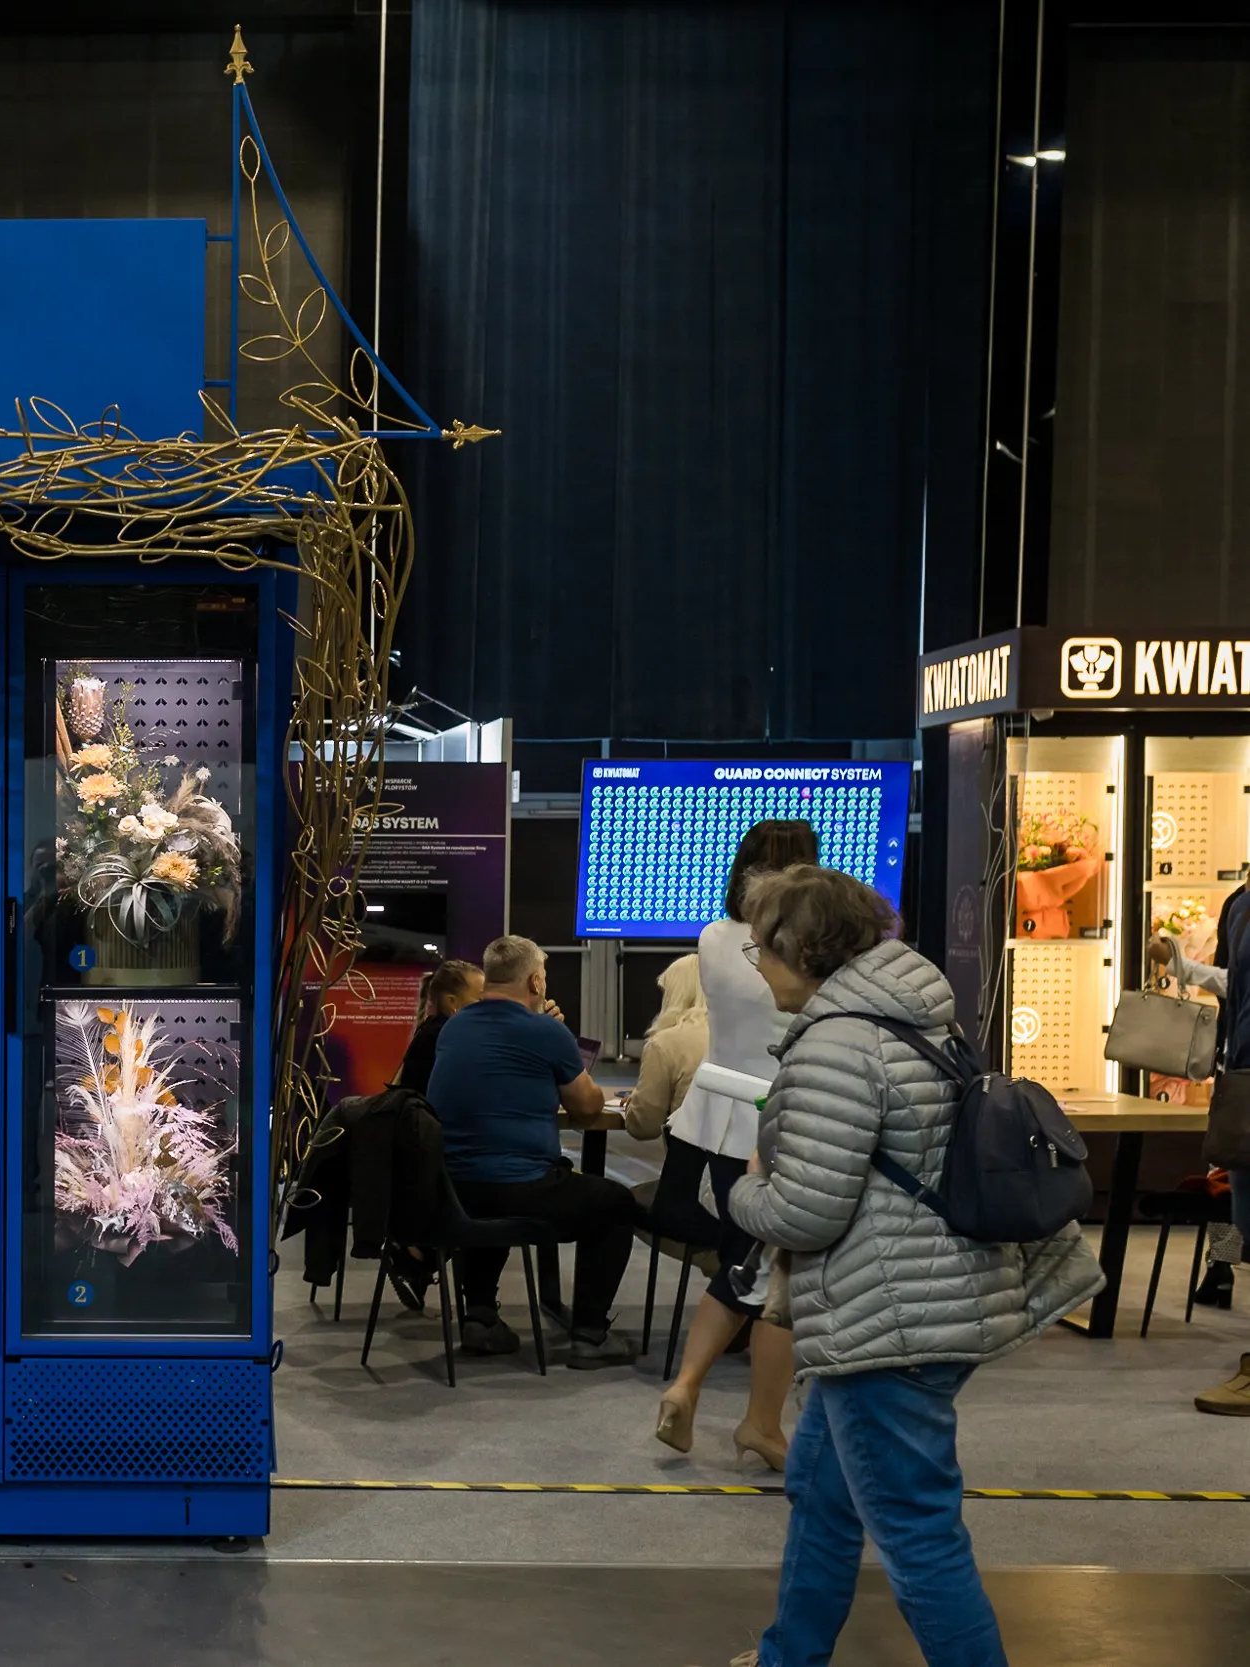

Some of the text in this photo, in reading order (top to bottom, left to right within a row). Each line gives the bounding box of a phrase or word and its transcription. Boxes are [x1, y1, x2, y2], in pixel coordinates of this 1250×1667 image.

[1134, 640, 1250, 695] KWIAT
[923, 644, 1011, 715] KWIATOMAT
[603, 767, 640, 778] KWIATOMAT
[713, 767, 882, 781] GUARD CONNECT SYSTEM
[382, 817, 439, 829] SYSTEM
[77, 949, 89, 967] 1
[74, 1285, 88, 1304] 2
